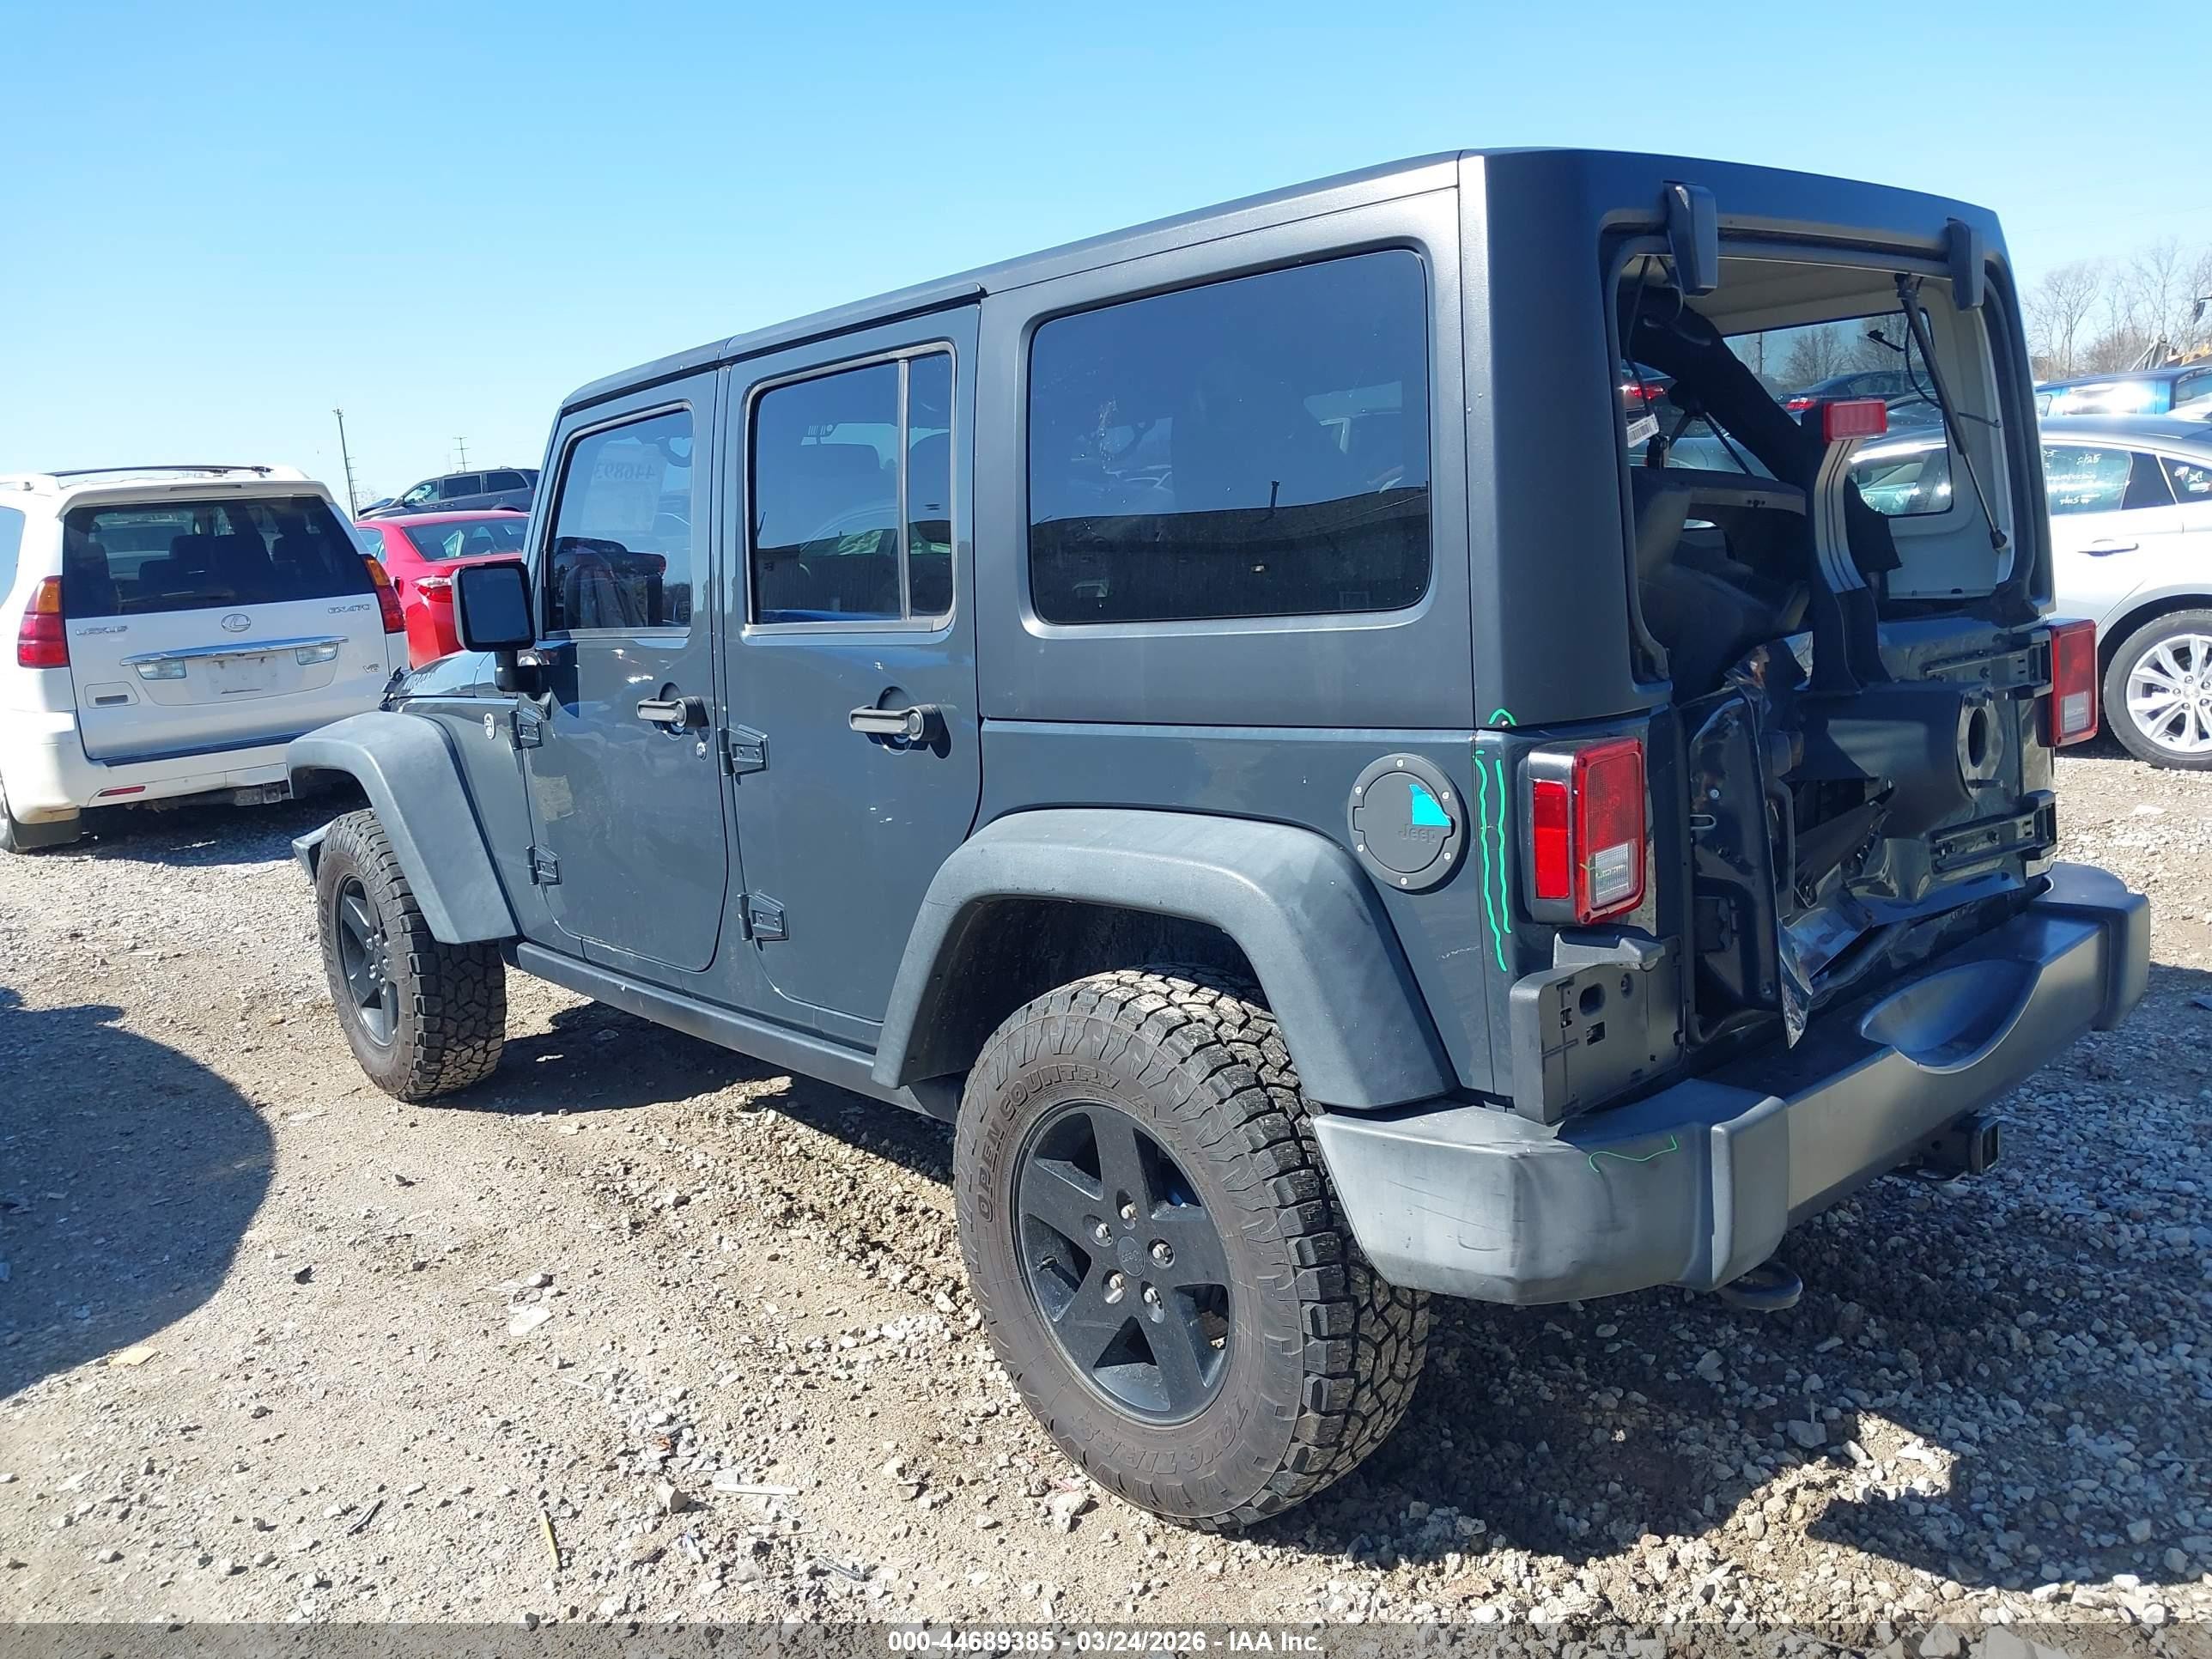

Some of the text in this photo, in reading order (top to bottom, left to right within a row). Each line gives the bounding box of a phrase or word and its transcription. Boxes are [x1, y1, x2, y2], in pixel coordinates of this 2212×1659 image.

[76, 625, 128, 636] LEXUS
[1397, 823, 1437, 845] Jeep
[977, 1117, 1006, 1223] OPEN
[999, 1064, 1120, 1121] COUNTRY
